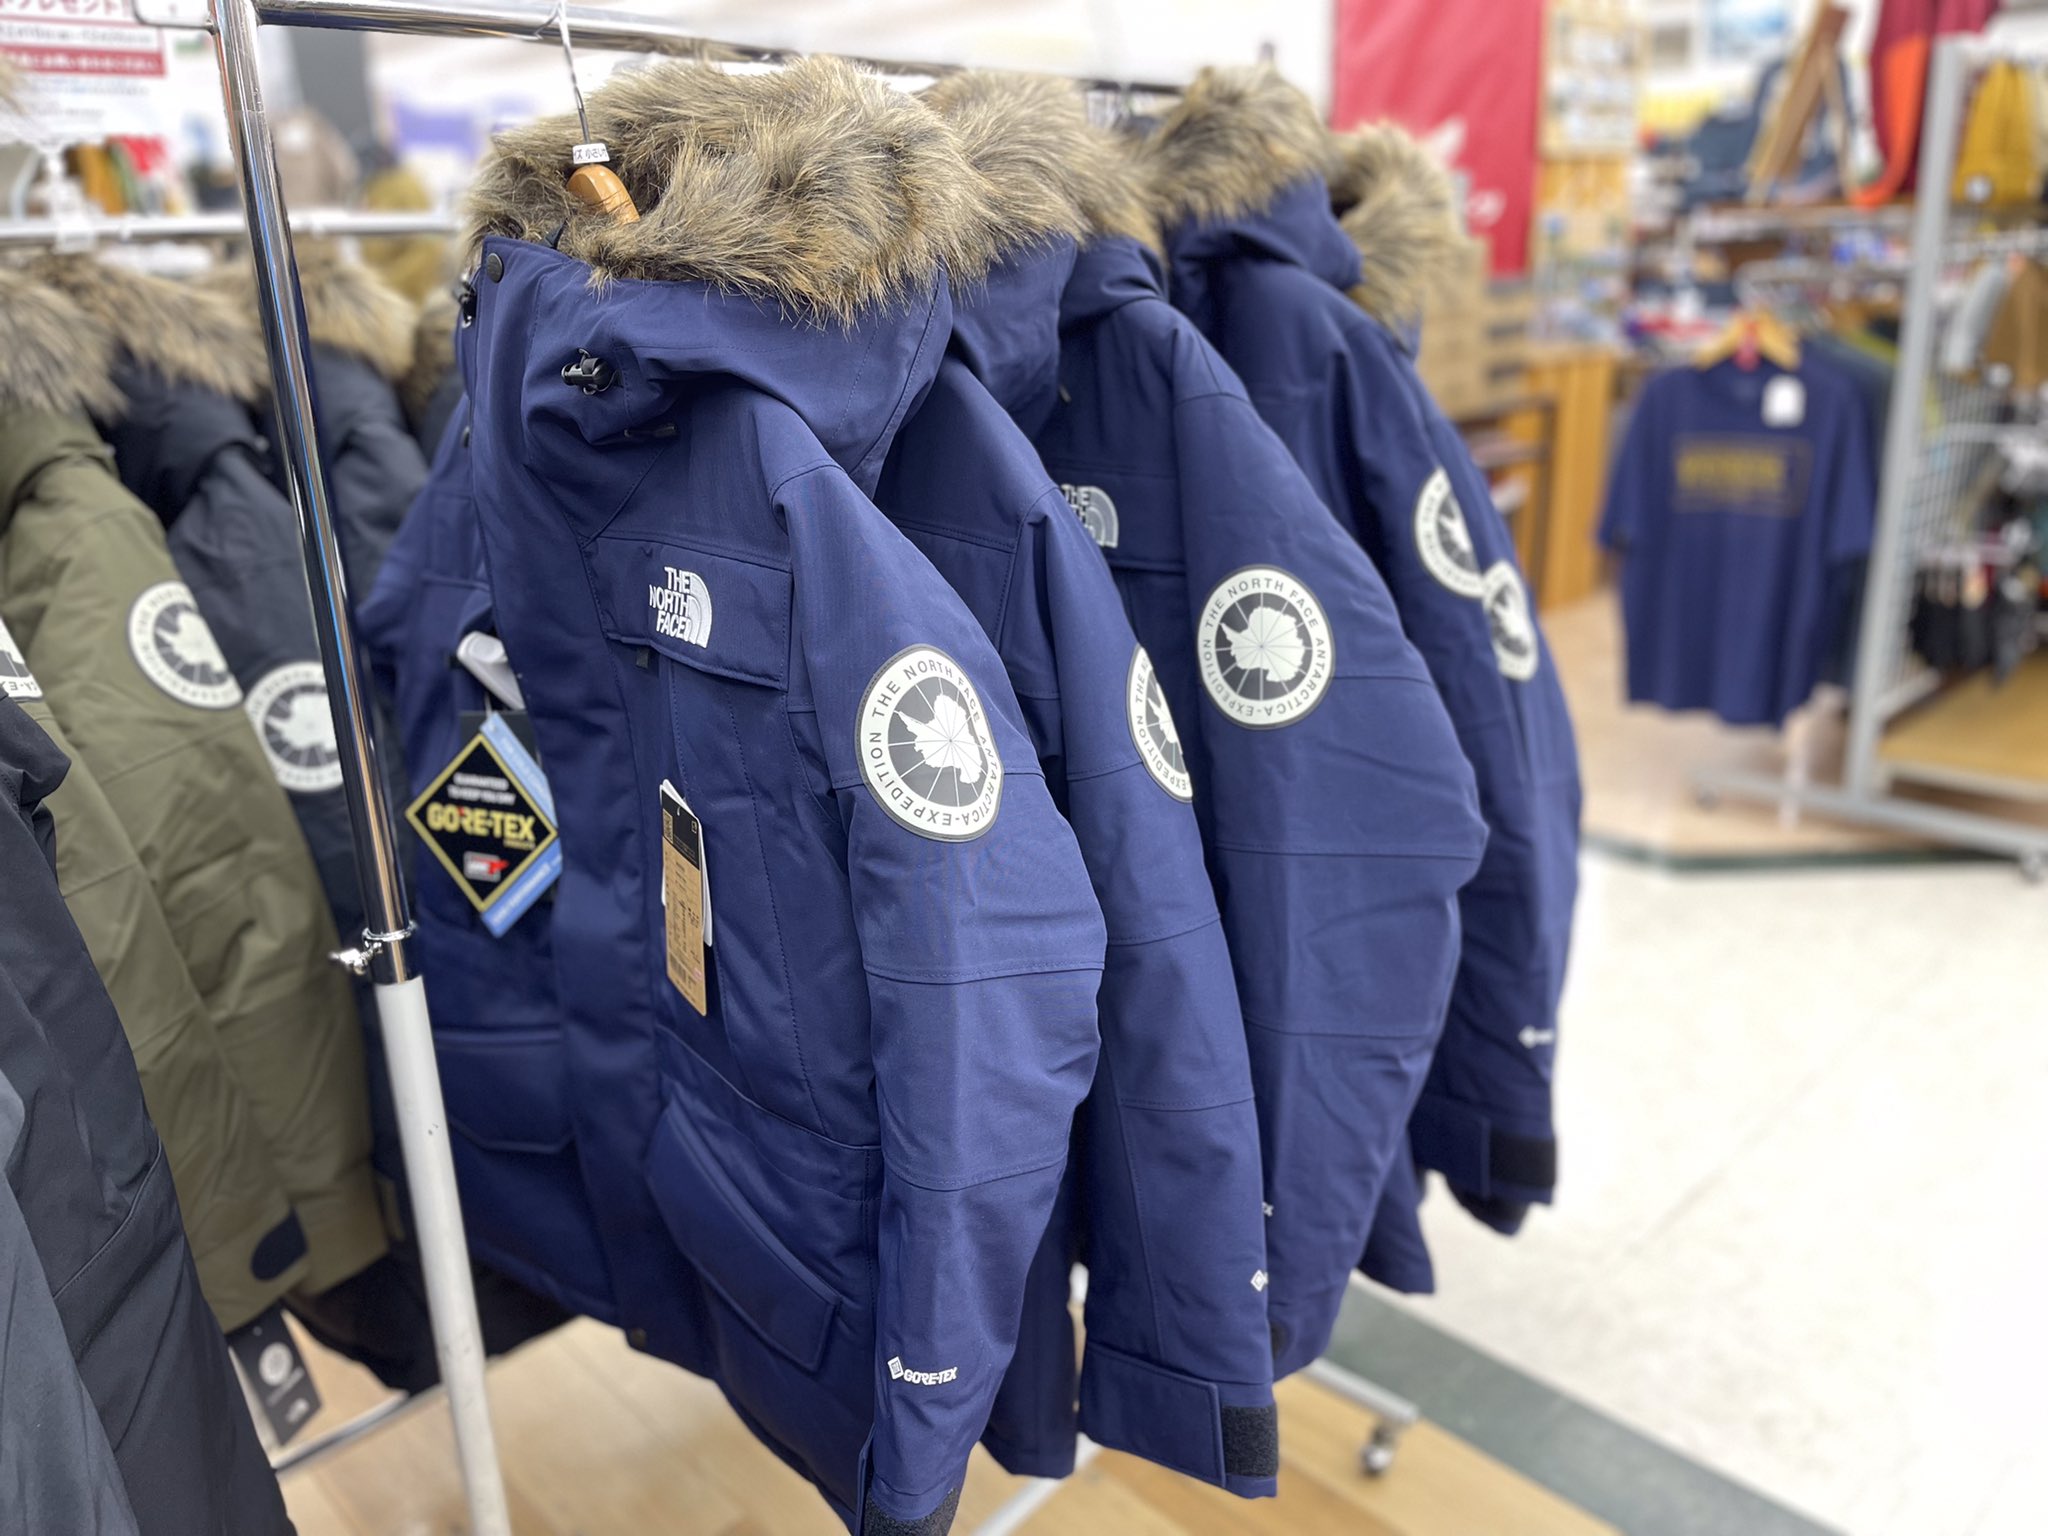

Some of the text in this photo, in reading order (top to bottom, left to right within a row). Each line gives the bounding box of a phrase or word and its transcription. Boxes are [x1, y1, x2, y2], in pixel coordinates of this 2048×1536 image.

[1061, 484, 1090, 506] THE
[664, 566, 691, 594] THE
[649, 584, 689, 617] NORTH
[1205, 598, 1225, 629] THE
[1227, 577, 1284, 598] NORTH
[1289, 590, 1319, 628] FACE
[656, 610, 686, 639] FACE
[871, 681, 901, 718] THE
[903, 659, 953, 681] NORTH
[958, 678, 980, 722] FACE
[1135, 673, 1146, 704] THE
[426, 802, 536, 841] GORE-TEX
[903, 1366, 958, 1386] GORE-TEX
